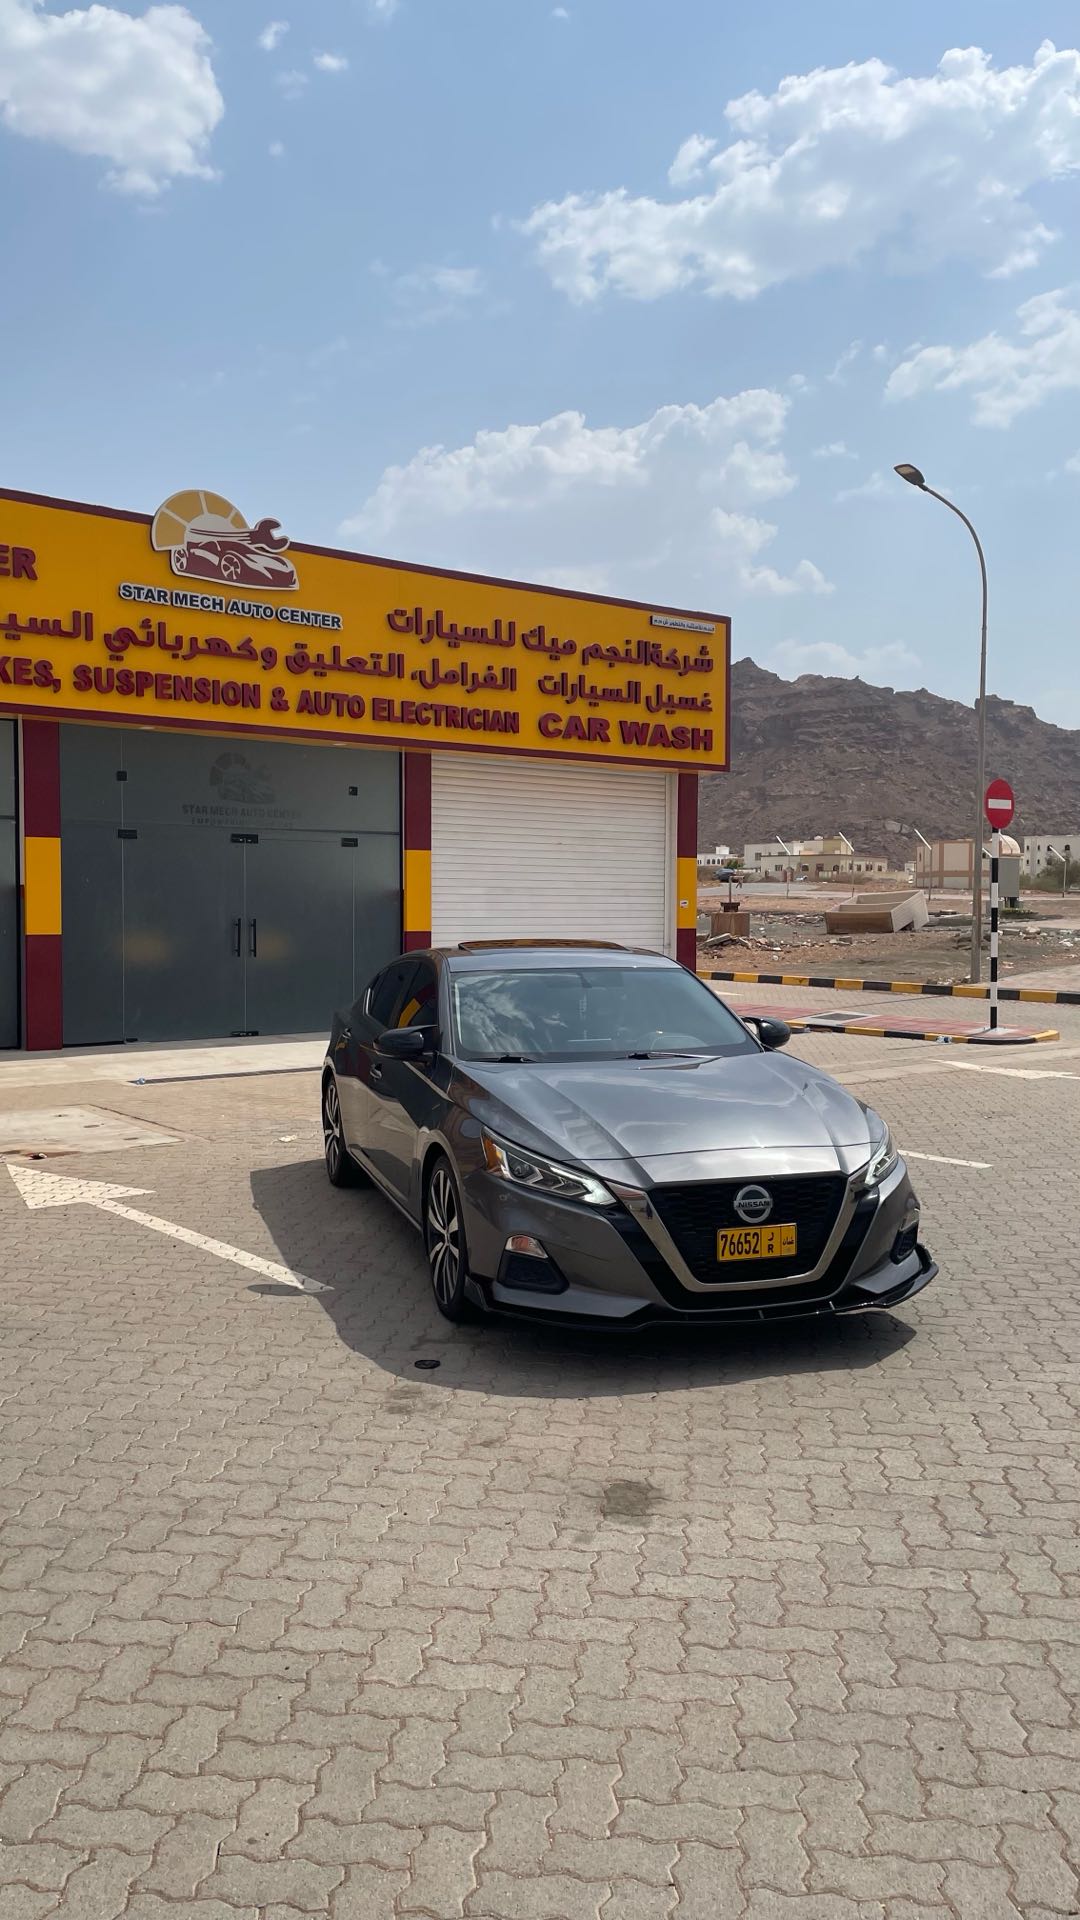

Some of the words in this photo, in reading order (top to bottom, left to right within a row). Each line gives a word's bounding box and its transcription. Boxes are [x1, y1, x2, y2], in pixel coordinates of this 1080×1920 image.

[120, 584, 169, 603] STAR
[175, 591, 224, 611] MECH
[230, 600, 274, 619] AUTO
[279, 608, 341, 628] CENTER
[387, 607, 516, 648] للسيارات
[521, 626, 577, 660] ميك
[286, 642, 404, 678] التعليق
[73, 664, 261, 709] SUSPENSION
[271, 686, 290, 711] &
[296, 689, 366, 719] AUTO
[372, 697, 520, 734] ELECTRICIAN
[538, 672, 641, 707] السيارات
[646, 684, 713, 715] غسيل
[538, 712, 610, 742] CAR
[619, 720, 713, 751] WASH
[182, 804, 208, 816] STAR
[738, 1200, 770, 1208] NISSAN
[720, 1232, 760, 1257] 76652
[767, 1244, 774, 1253] R
